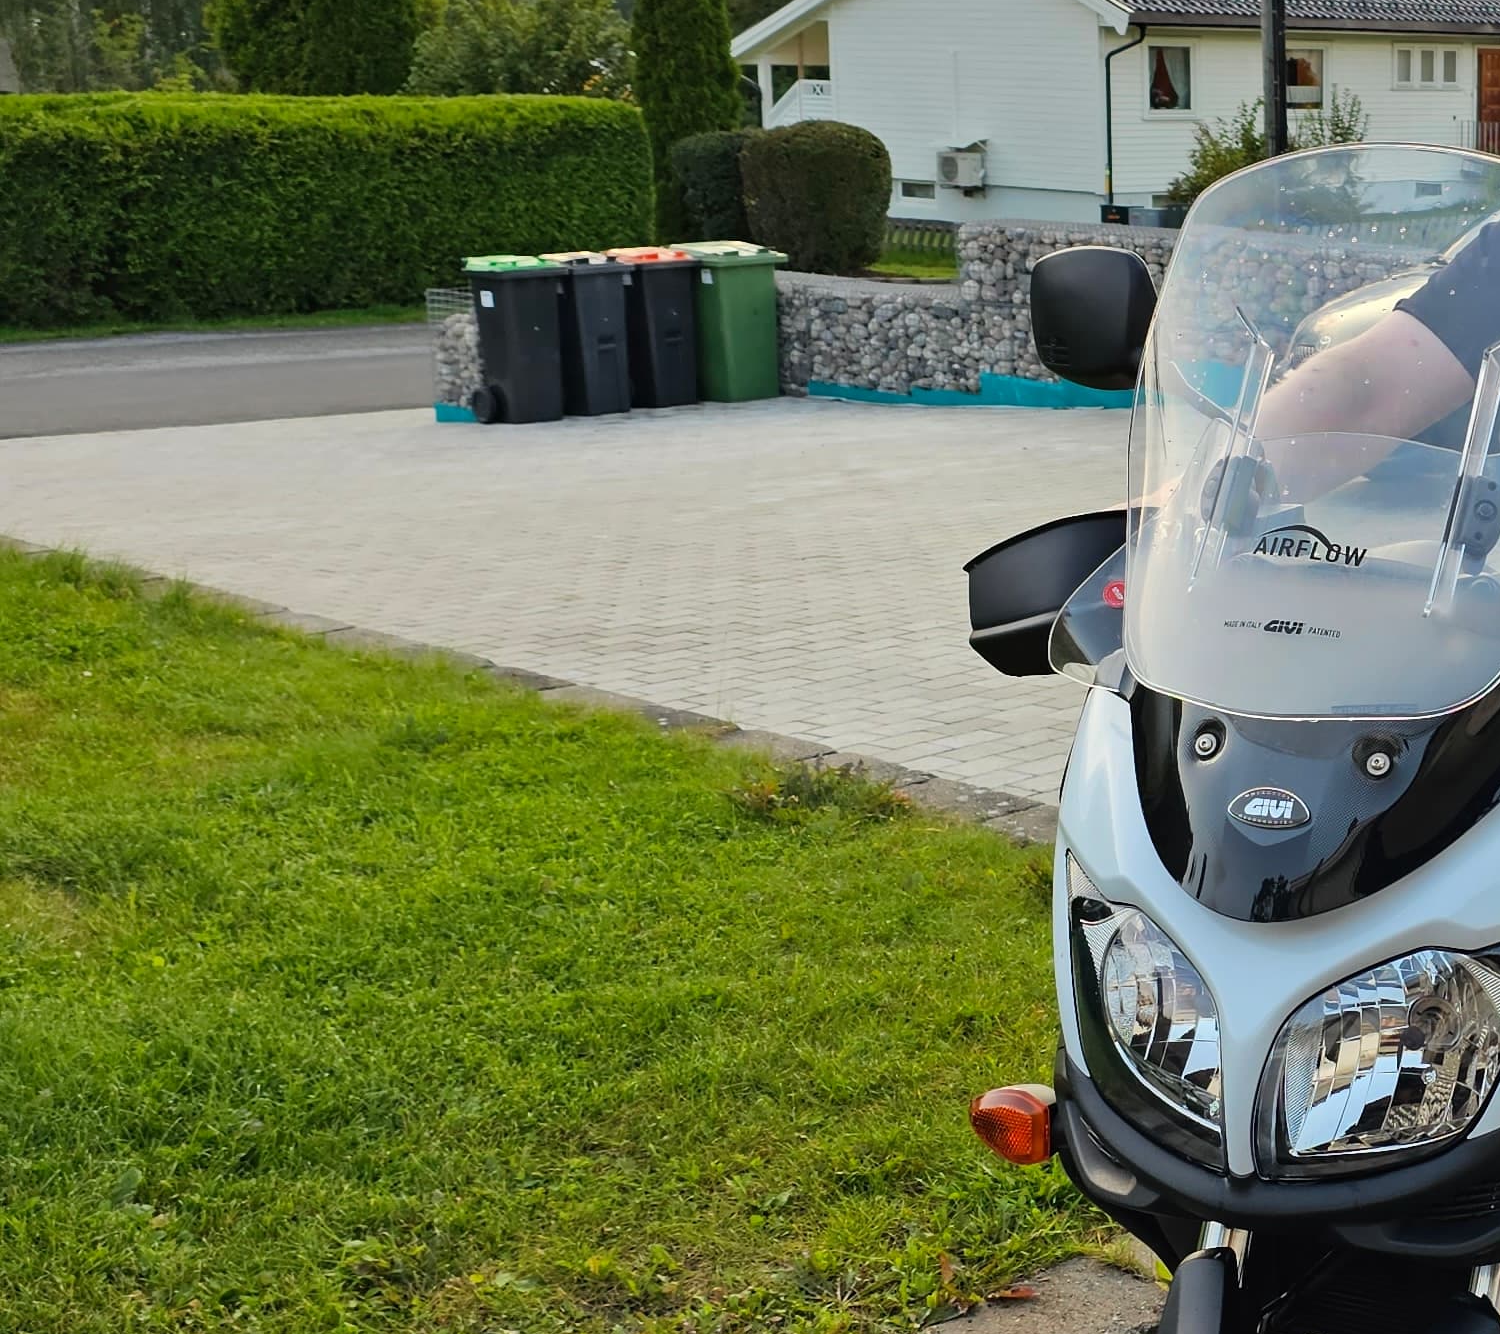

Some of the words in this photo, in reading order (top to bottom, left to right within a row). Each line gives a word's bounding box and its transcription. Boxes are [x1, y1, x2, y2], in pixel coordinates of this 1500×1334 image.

[1253, 536, 1368, 567] AIRFLOW
[1263, 619, 1304, 635] GIVI
[1307, 626, 1341, 639] PATENTED
[1244, 797, 1294, 819] GIVI
